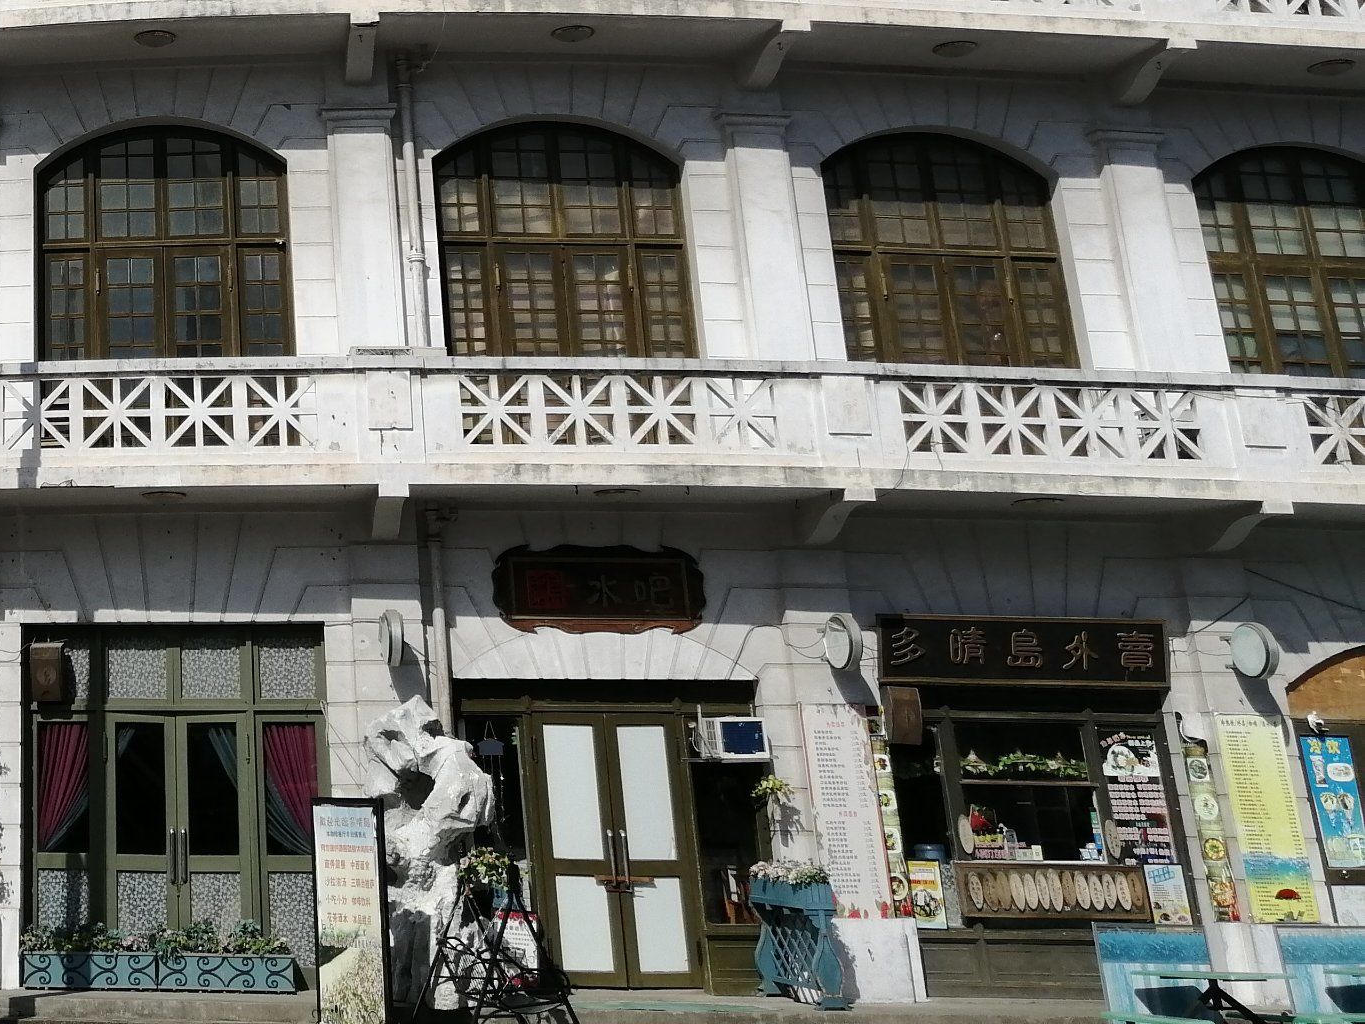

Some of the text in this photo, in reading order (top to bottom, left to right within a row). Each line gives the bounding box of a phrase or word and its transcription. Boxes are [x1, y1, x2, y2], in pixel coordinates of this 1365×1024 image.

[890, 626, 1155, 673] 多晴島外賣
